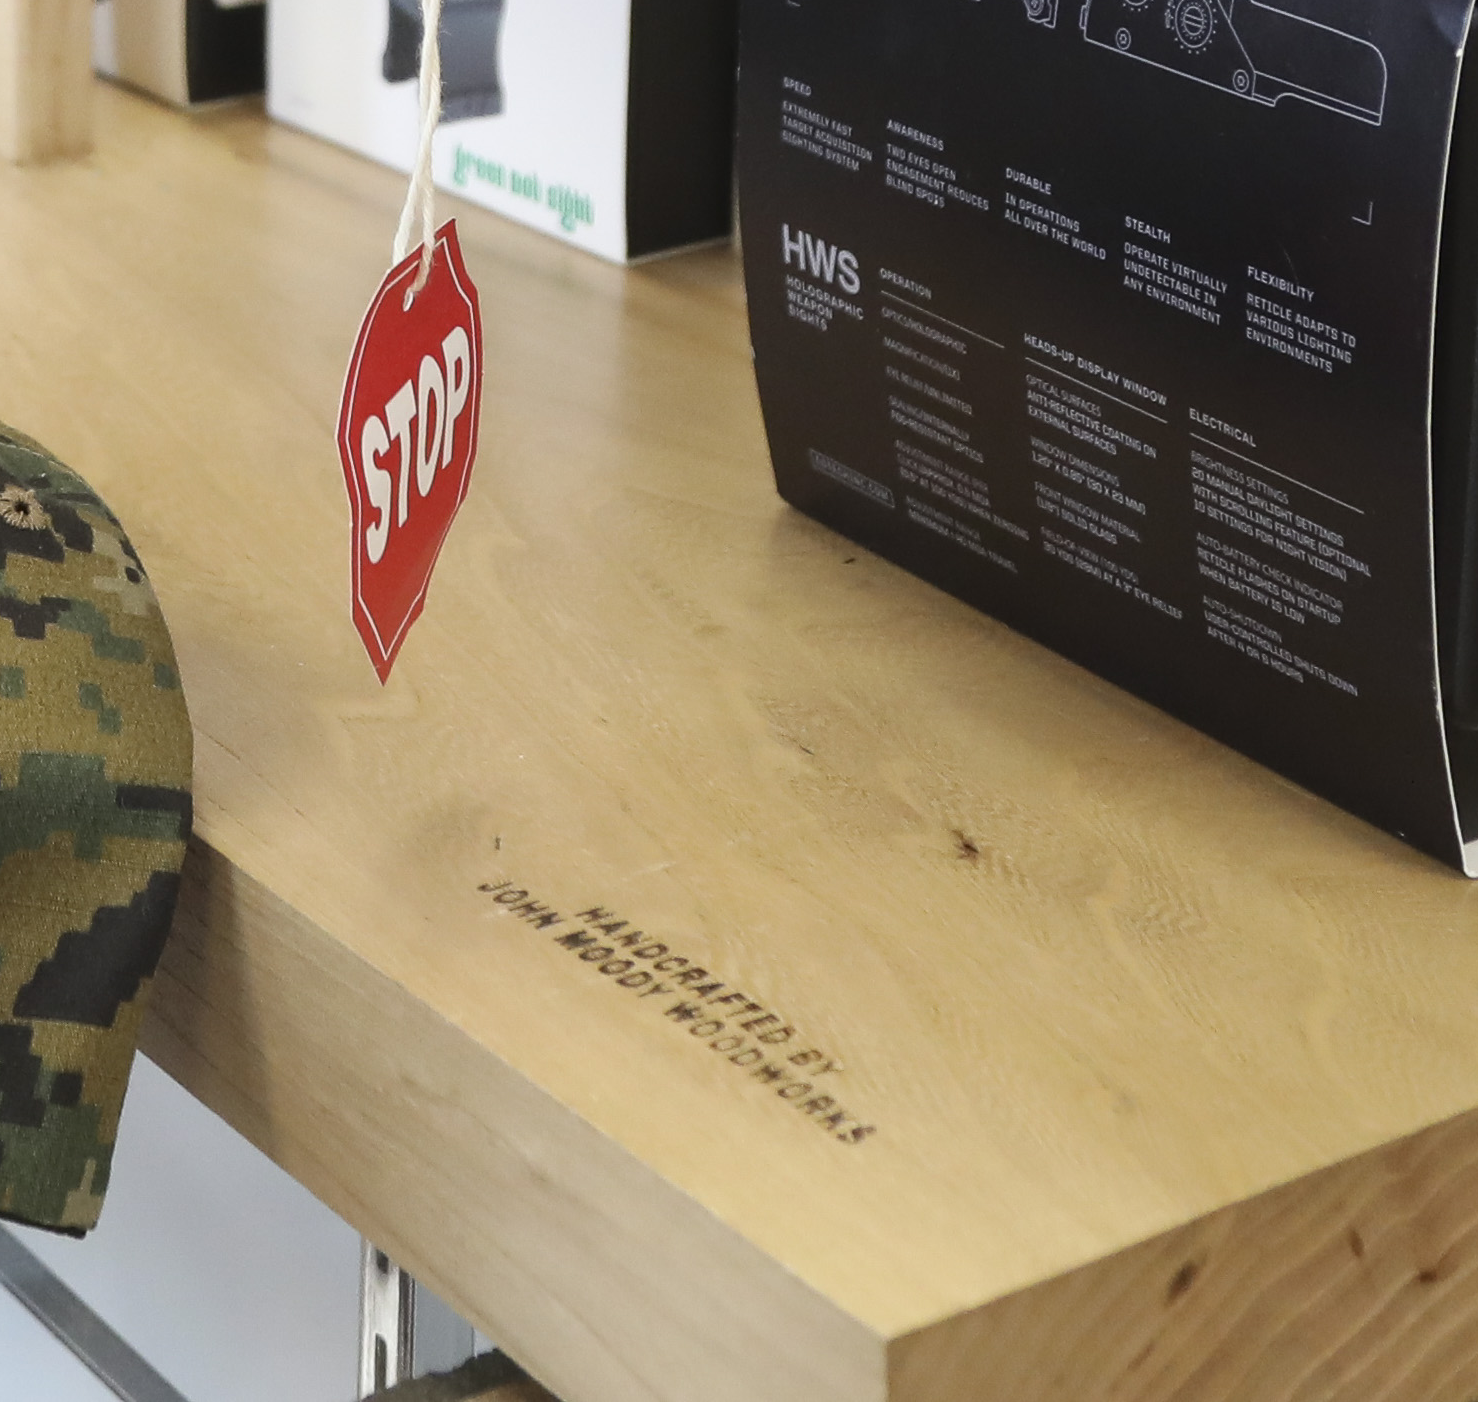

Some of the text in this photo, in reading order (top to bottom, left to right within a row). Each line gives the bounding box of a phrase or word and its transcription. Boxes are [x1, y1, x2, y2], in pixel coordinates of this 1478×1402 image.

[783, 76, 811, 98] SPEED
[783, 100, 852, 137] EXTREMELY FAST
[783, 115, 872, 162] TARGET ACQUISITION
[887, 117, 944, 151] AWARENESS
[782, 129, 859, 172] SIGHTING SYSTEM
[887, 142, 955, 180] TWO EYES OPEN
[886, 173, 913, 195] BLIND
[887, 157, 988, 211] ENGAGEMENT REDUCES
[1005, 166, 1051, 195] DURABLE
[1004, 207, 1106, 261] ALL OVER THE WORLD
[1005, 191, 1079, 232] IN OPERATIONS
[1124, 214, 1170, 244] STEALTH
[782, 221, 860, 295] HWS
[880, 266, 931, 299] OPERATION
[1124, 241, 1227, 294] OPERATE VIRTUALLY
[1124, 258, 1216, 307] UNDETECTABLE IN
[786, 274, 864, 321] HOLOGRAPHIC
[787, 289, 832, 319] WEAPON
[1123, 274, 1220, 325] ANY ENVIRONMENT
[1247, 265, 1313, 302] FLEXIBILITY
[788, 302, 827, 331] SIGHTS
[1246, 291, 1355, 348] RETICLE ADAPTS TO
[1246, 309, 1351, 364] VARIOUS LIGHTING
[1024, 332, 1167, 407] HEADS-UP DISPLAY WINDOW
[1246, 326, 1332, 373] ENVIRONMENTS
[1026, 373, 1101, 417] OPTICAL SURFACES
[363, 323, 472, 567] STOP
[1027, 388, 1156, 459] ANTI-REFLECTIVE COATING ON
[1028, 404, 1116, 455] EXTERNAL SURFACES
[1189, 406, 1256, 448] ELECTRICAL
[1030, 436, 1119, 487] WINDOW DIMENSIONS
[1191, 449, 1289, 505] BRIGHTNESS SETTINGS
[1062, 494, 1140, 542] WINDOW MATERIAL
[1191, 481, 1371, 577] WITH SCROLLING FEATURE (OPTIONAL
[1206, 472, 1344, 548] MANUAL DAYLIGHT SETTINGS
[1193, 497, 1347, 581] 10 SETTINGS FOR NIGHT VISION)
[1196, 530, 1343, 612] AUTO-BATTERY CHECK INDICATOR
[1197, 546, 1341, 627] RETICLE FLASHES ON STARTUP
[1197, 561, 1305, 624] WHEN BATTERY IS LOW
[1327, 671, 1358, 696] DOWN
[477, 879, 877, 1144] JOHN MOODY WOODWORKS
[575, 906, 845, 1077] HANDCRAFTED BY
